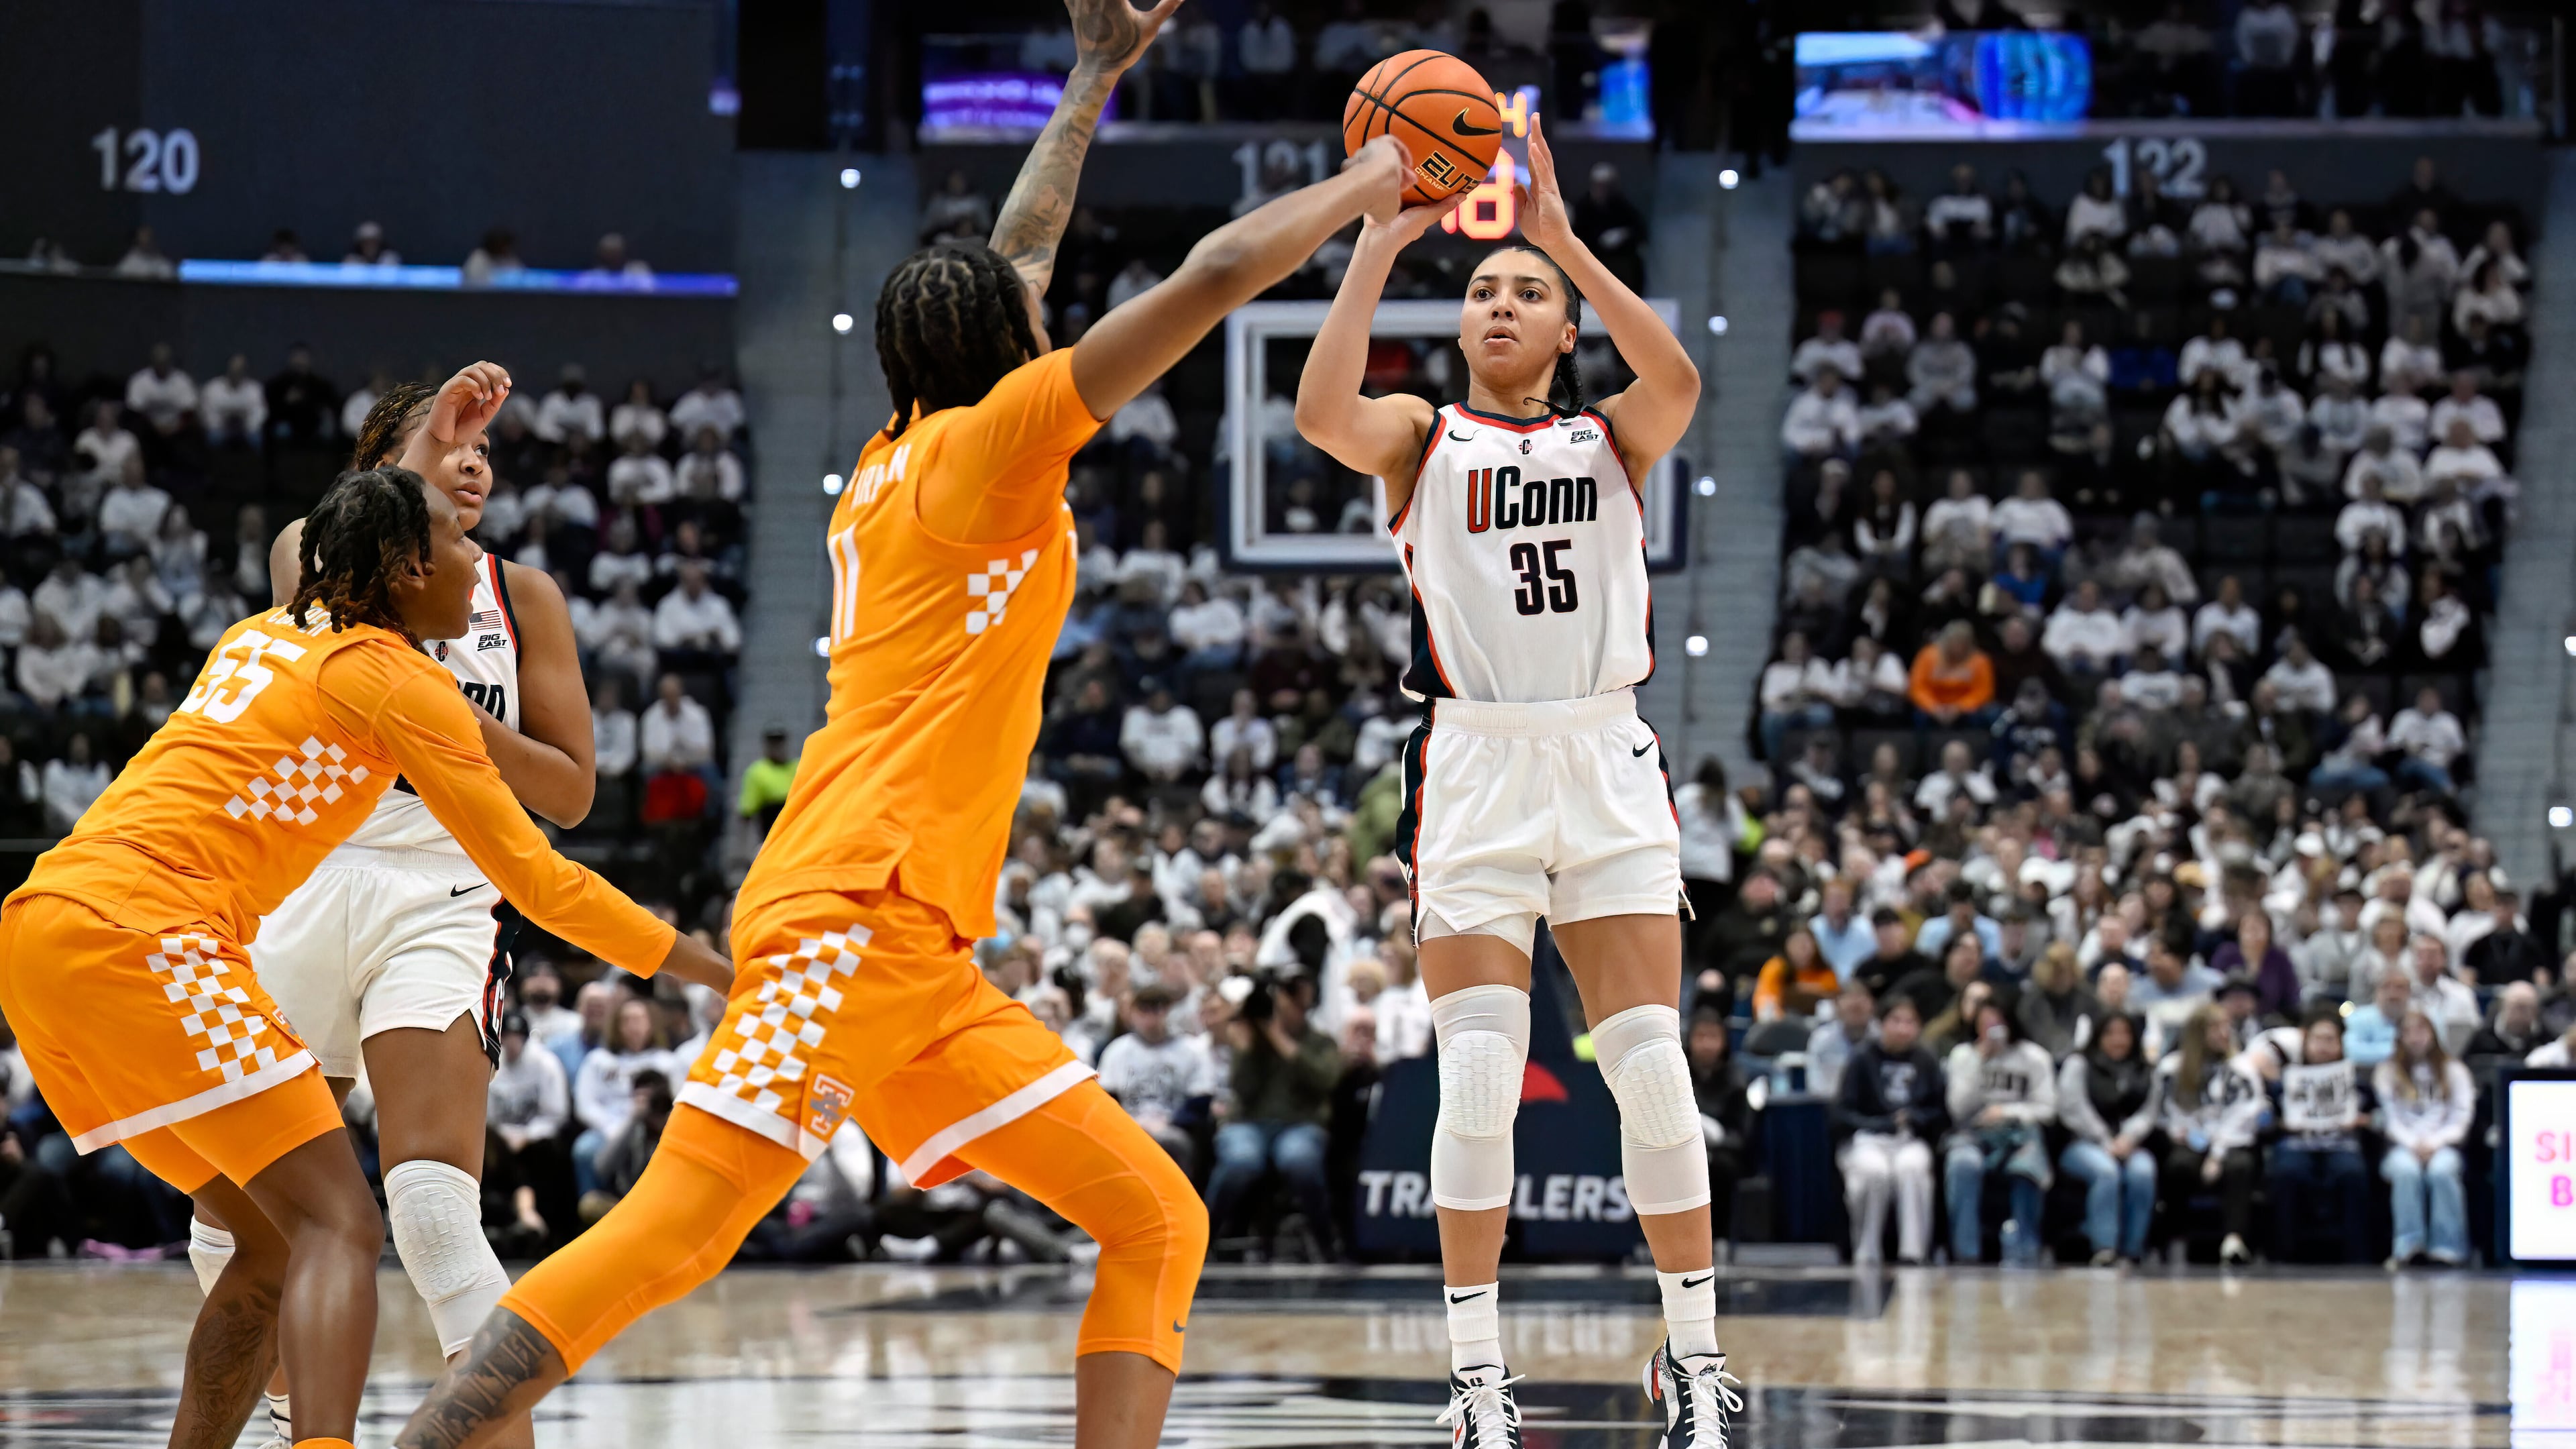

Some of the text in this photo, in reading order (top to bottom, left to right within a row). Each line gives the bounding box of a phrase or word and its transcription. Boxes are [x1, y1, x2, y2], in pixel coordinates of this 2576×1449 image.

[93, 127, 200, 194] 120
[2104, 138, 2206, 195] 122
[1467, 466, 1597, 533] UConn
[828, 523, 859, 646] 11
[1509, 539, 1578, 615] 35
[478, 639, 507, 648] EAST
[479, 633, 500, 642] BIG
[178, 629, 308, 724] 55
[1358, 1170, 1635, 1222] TRLERS
